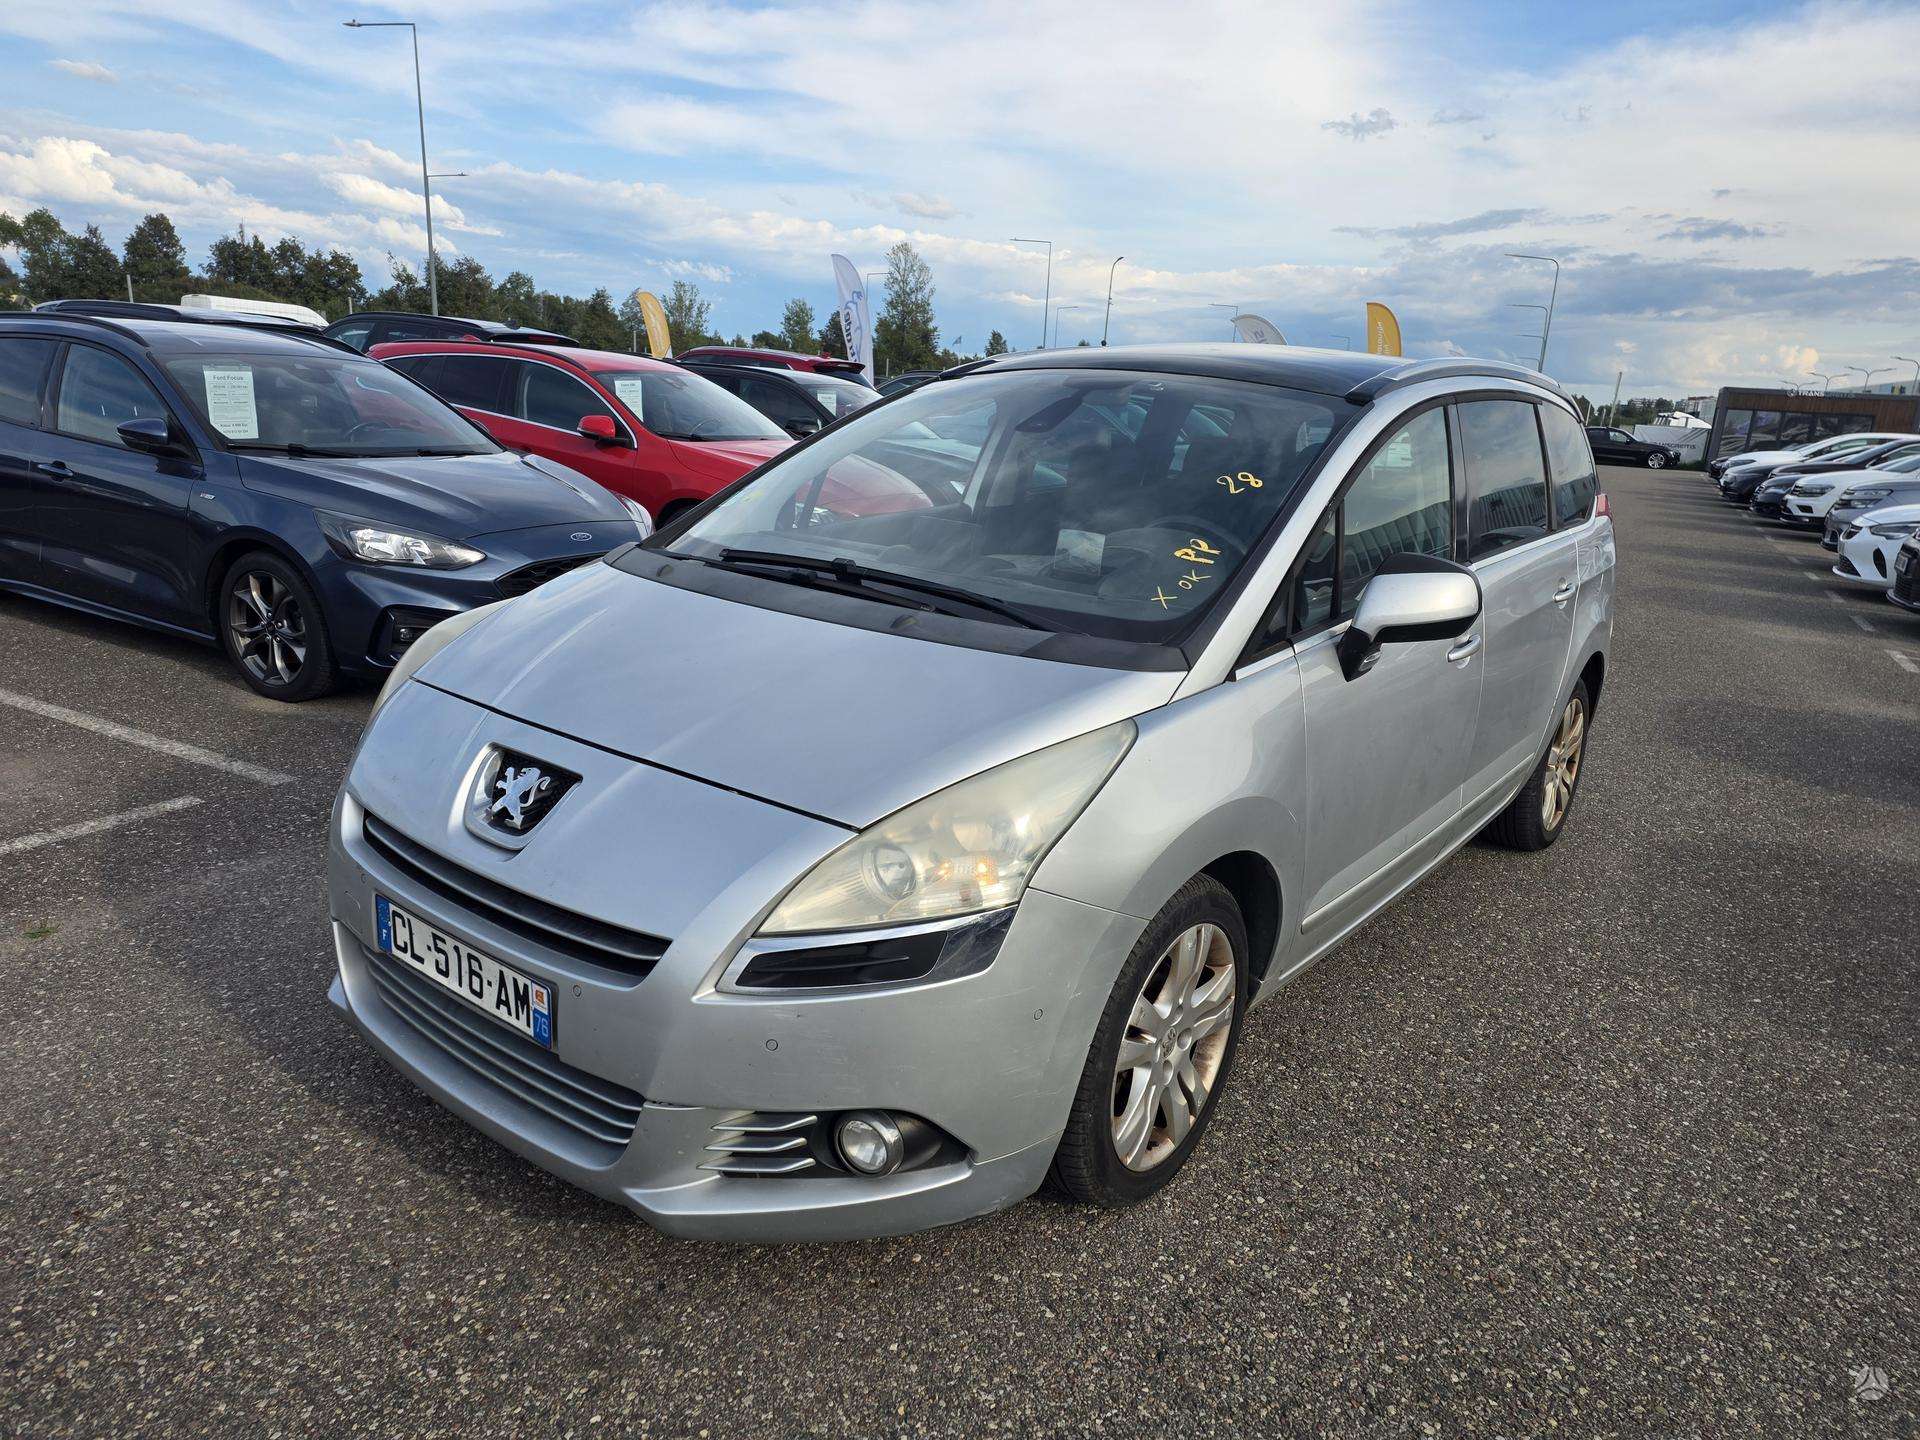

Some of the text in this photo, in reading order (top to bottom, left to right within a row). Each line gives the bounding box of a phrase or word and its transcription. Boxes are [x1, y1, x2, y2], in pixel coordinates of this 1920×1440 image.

[1216, 471, 1263, 494] 28
[382, 929, 387, 941] F
[391, 909, 531, 1029] CL-516-AM
[534, 1012, 549, 1038] 76
